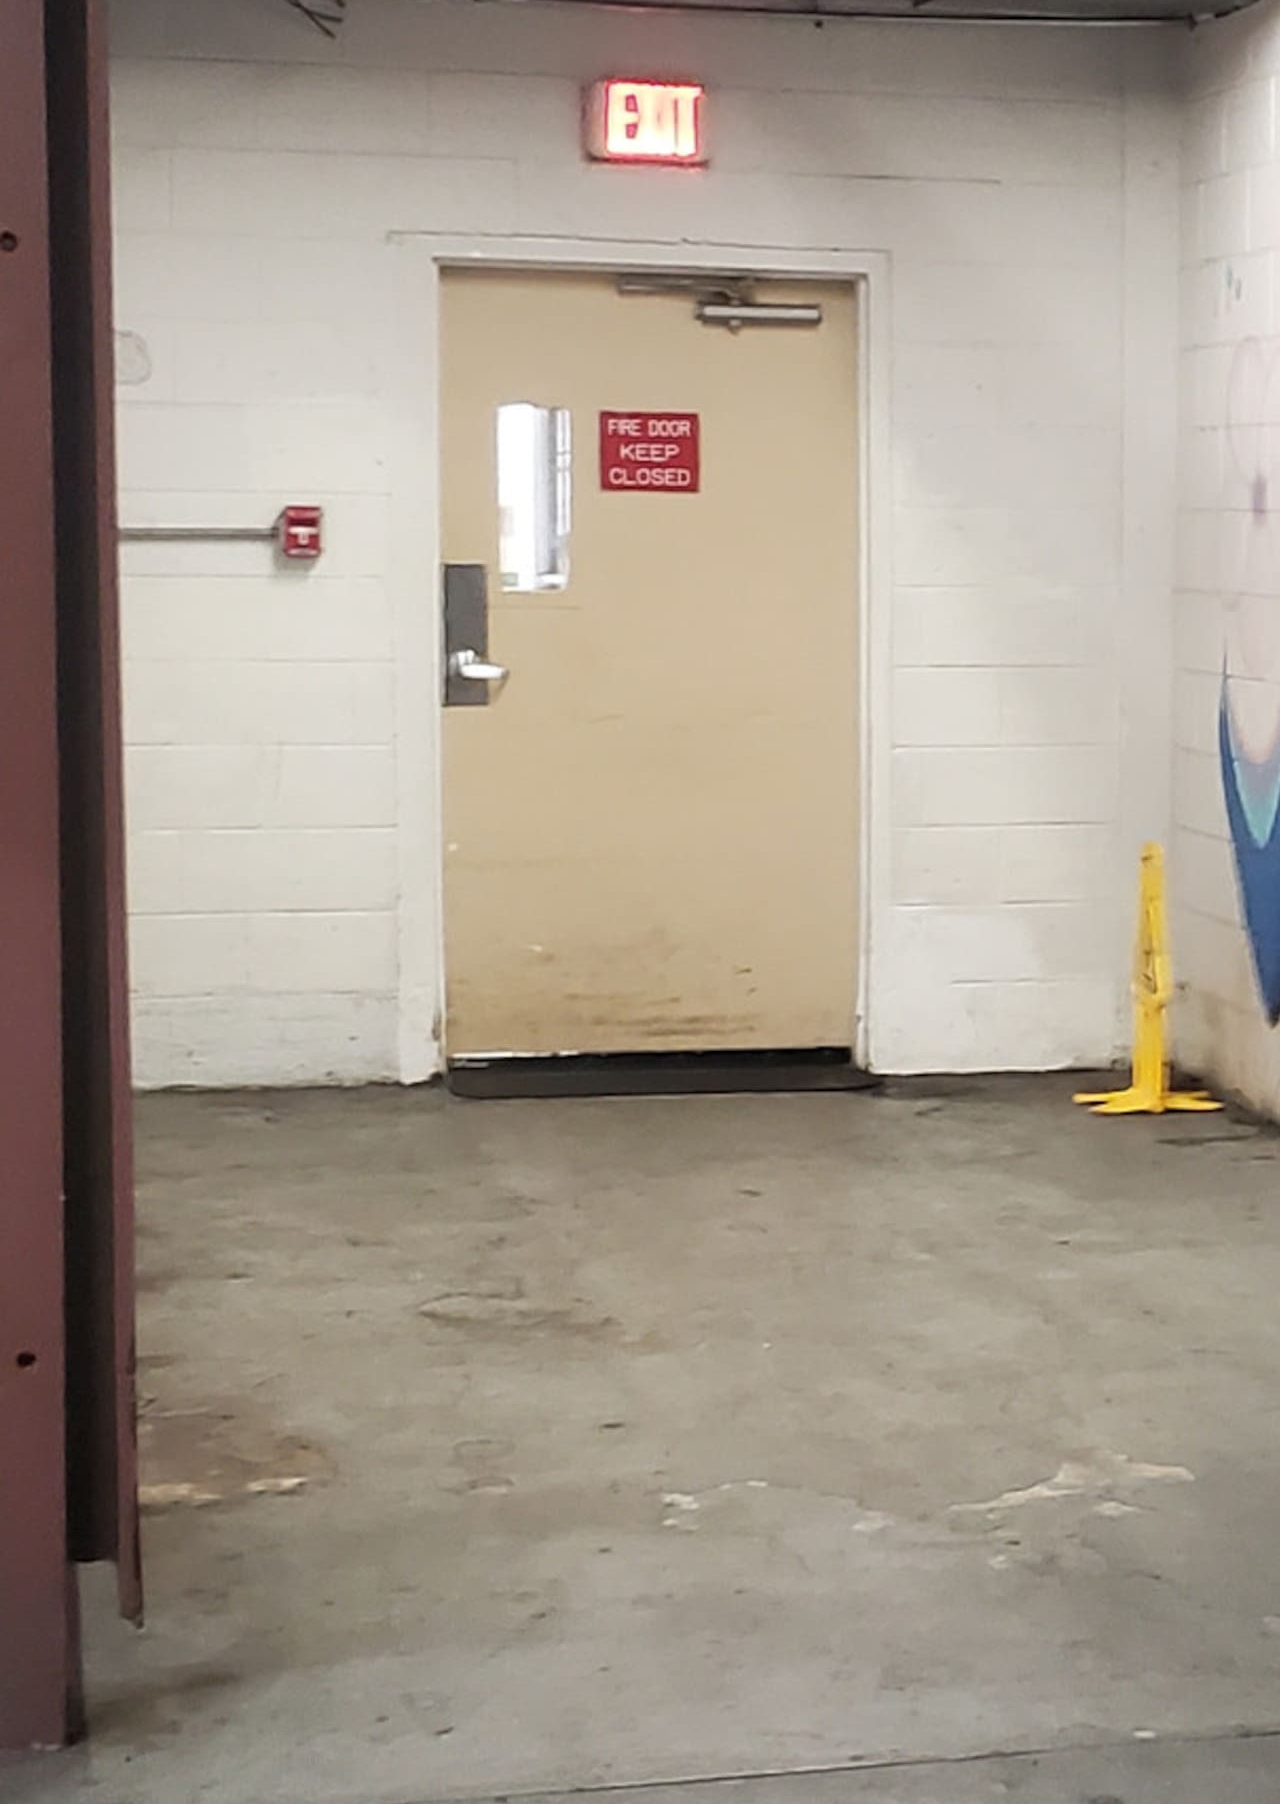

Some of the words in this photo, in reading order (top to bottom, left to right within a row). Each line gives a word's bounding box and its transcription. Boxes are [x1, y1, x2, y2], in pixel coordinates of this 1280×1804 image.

[607, 82, 704, 157] EXIT
[607, 418, 643, 437] FIRE
[648, 418, 691, 438] DOOR
[620, 442, 680, 462] KEEP
[609, 466, 691, 487] CLOSED
